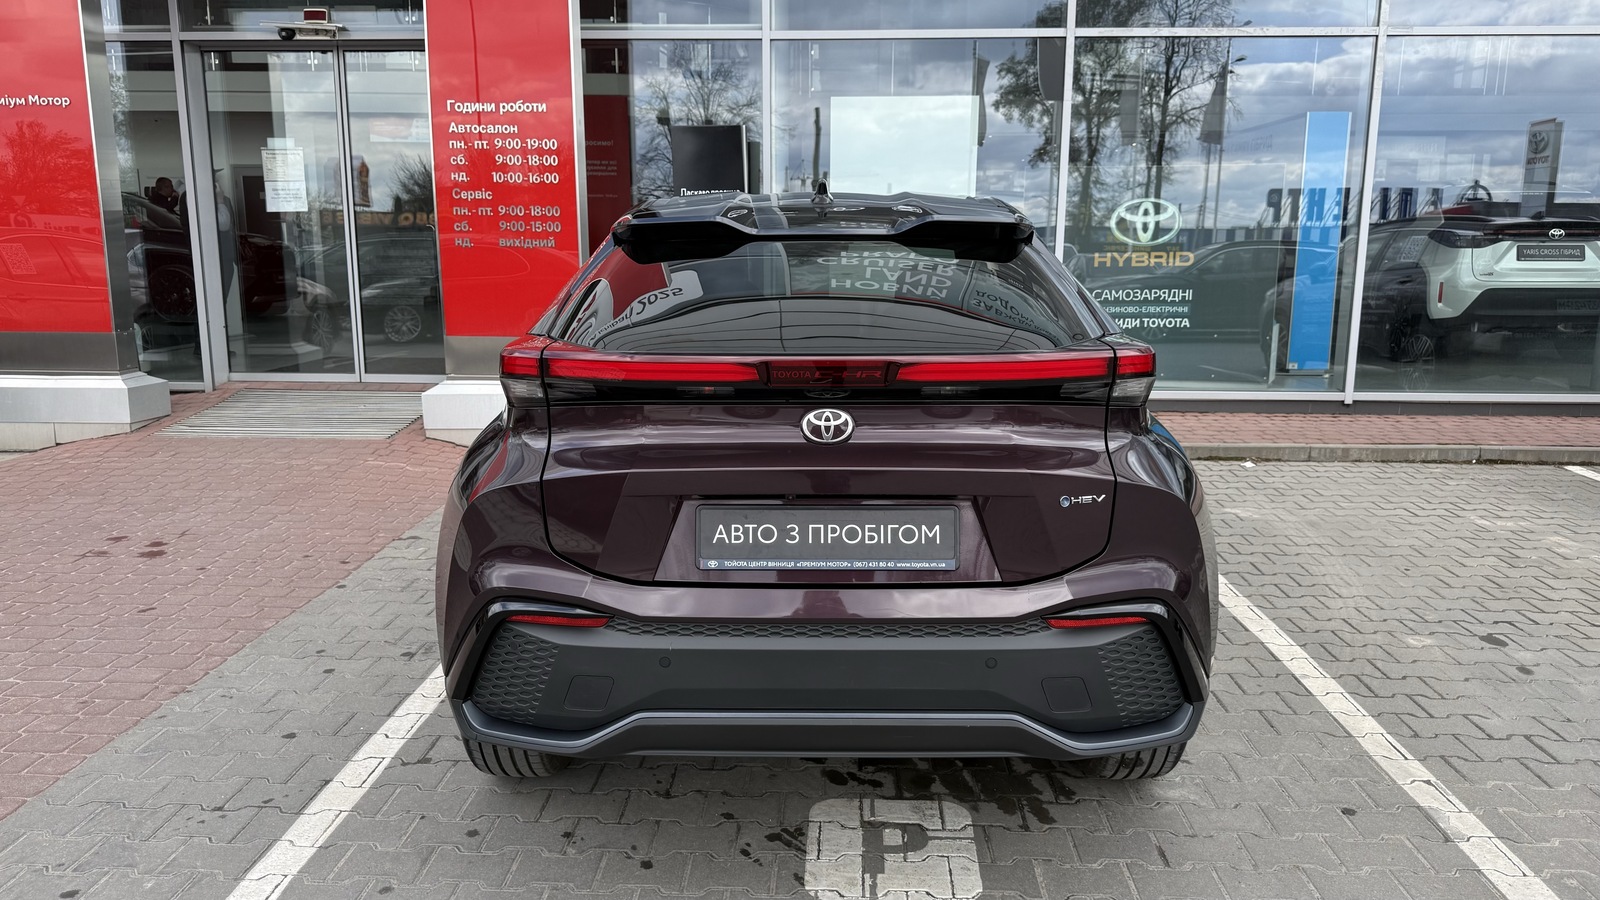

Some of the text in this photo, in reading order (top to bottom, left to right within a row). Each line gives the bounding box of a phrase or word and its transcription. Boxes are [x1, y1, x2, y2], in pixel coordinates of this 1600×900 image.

[28, 94, 71, 108] Мотор
[446, 100, 547, 115] Години роботи
[448, 122, 518, 134] Автосалон
[494, 138, 558, 150] 9:00-19:00
[450, 154, 559, 166] сб. 9:00-18:00
[451, 171, 559, 183] нд. 10:00-16:00
[452, 188, 493, 202] Сервіс
[498, 205, 561, 217] 9:00-18:00
[453, 221, 562, 232] сб. 9:00-15:00
[454, 237, 555, 248] нд. вихідний
[1540, 248, 1560, 256] CROSS
[1093, 251, 1195, 268] HYBRID
[1092, 289, 1193, 302] САМОЗАРЯДНІ
[1142, 318, 1190, 328] TOYOTA
[772, 370, 811, 378] TOYOTA
[1071, 494, 1106, 505] HEV
[712, 524, 778, 544] АВТО
[808, 524, 941, 544] ПРОБІГОМ
[853, 561, 868, 569] (067)
[896, 561, 946, 569] www.toyota.vn.ua
[862, 823, 929, 875] P
